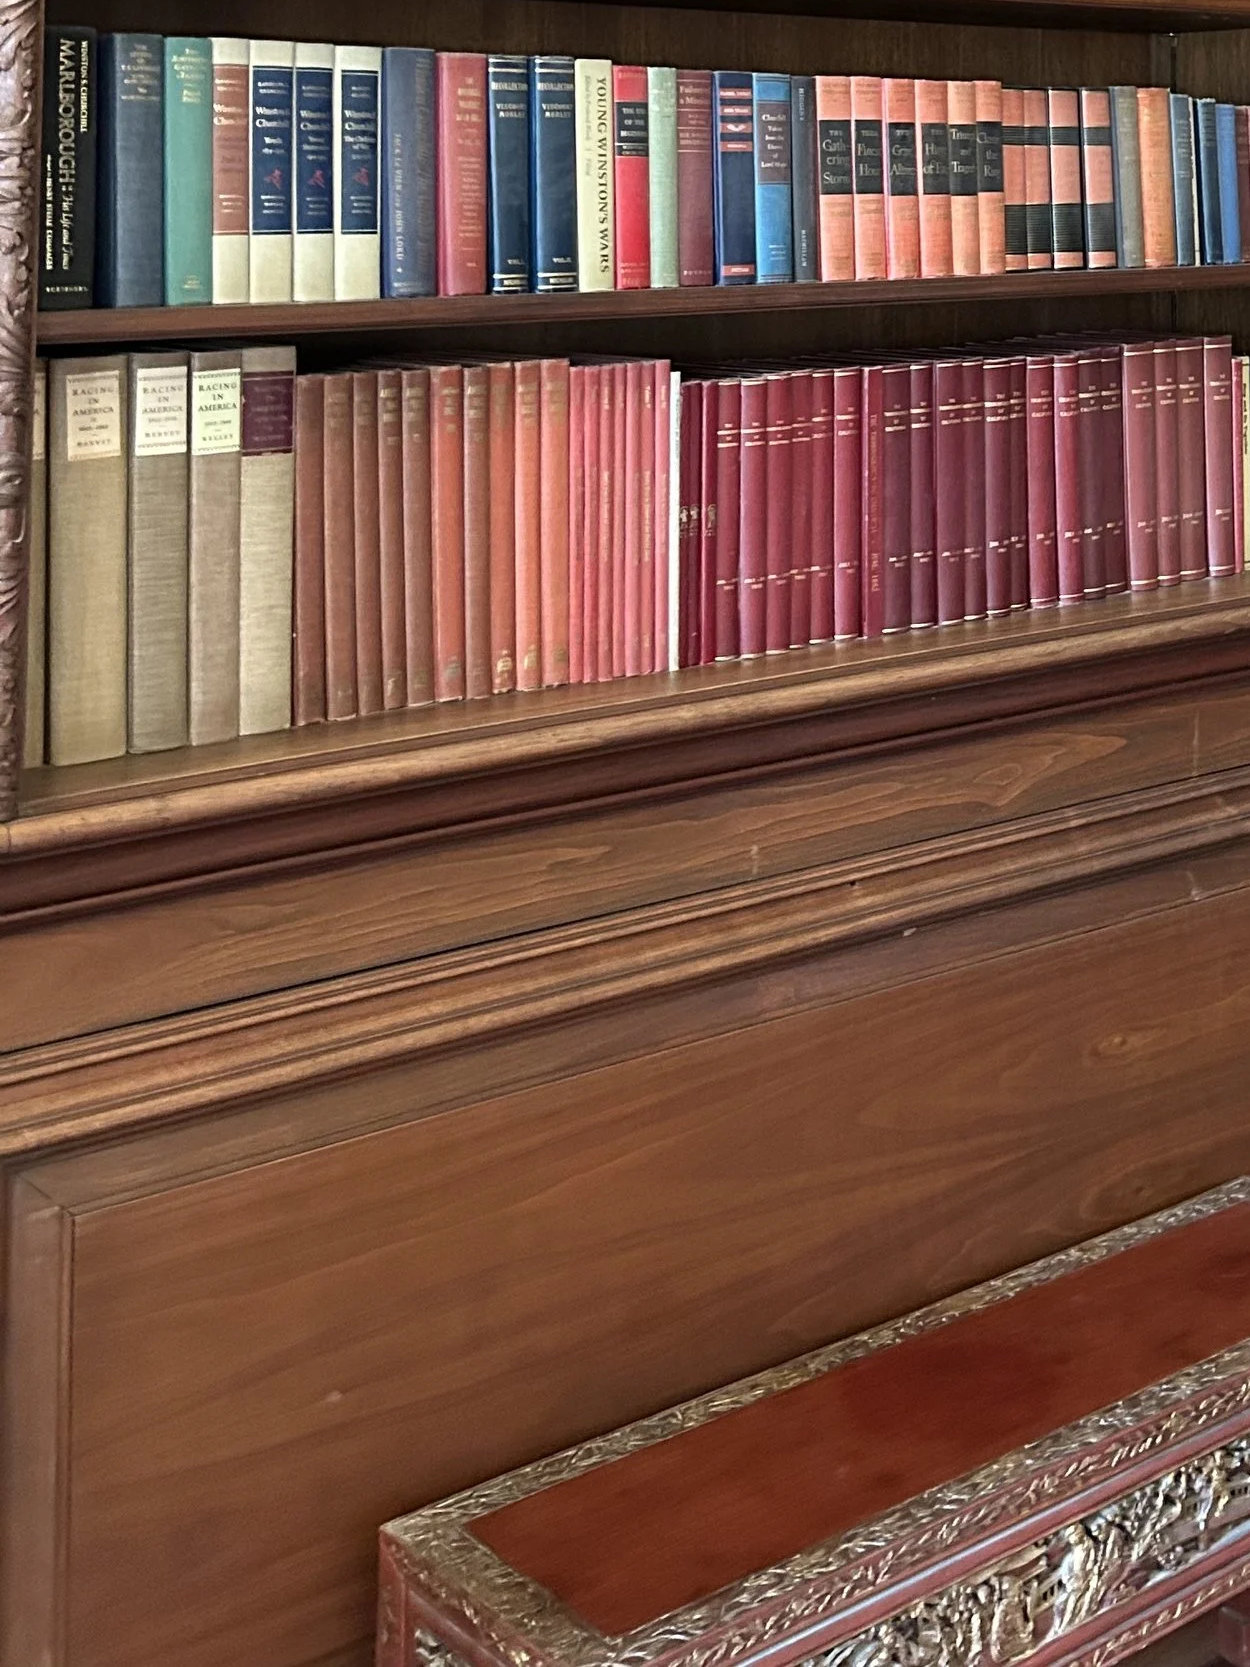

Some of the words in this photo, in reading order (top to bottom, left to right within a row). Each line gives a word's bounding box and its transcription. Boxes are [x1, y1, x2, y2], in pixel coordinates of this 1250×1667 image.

[80, 87, 89, 133] CHURCHILL
[596, 77, 608, 135] YOUNG
[59, 38, 76, 192] MARLBOROUGH:
[597, 137, 610, 226] WINSTON'S
[598, 229, 611, 274] WARS
[72, 386, 114, 397] RACING
[143, 385, 184, 395] RACING
[198, 383, 237, 393] RACING
[72, 406, 114, 416] AMERICA
[142, 406, 183, 415] AMERICA
[197, 403, 237, 412] AMERICA
